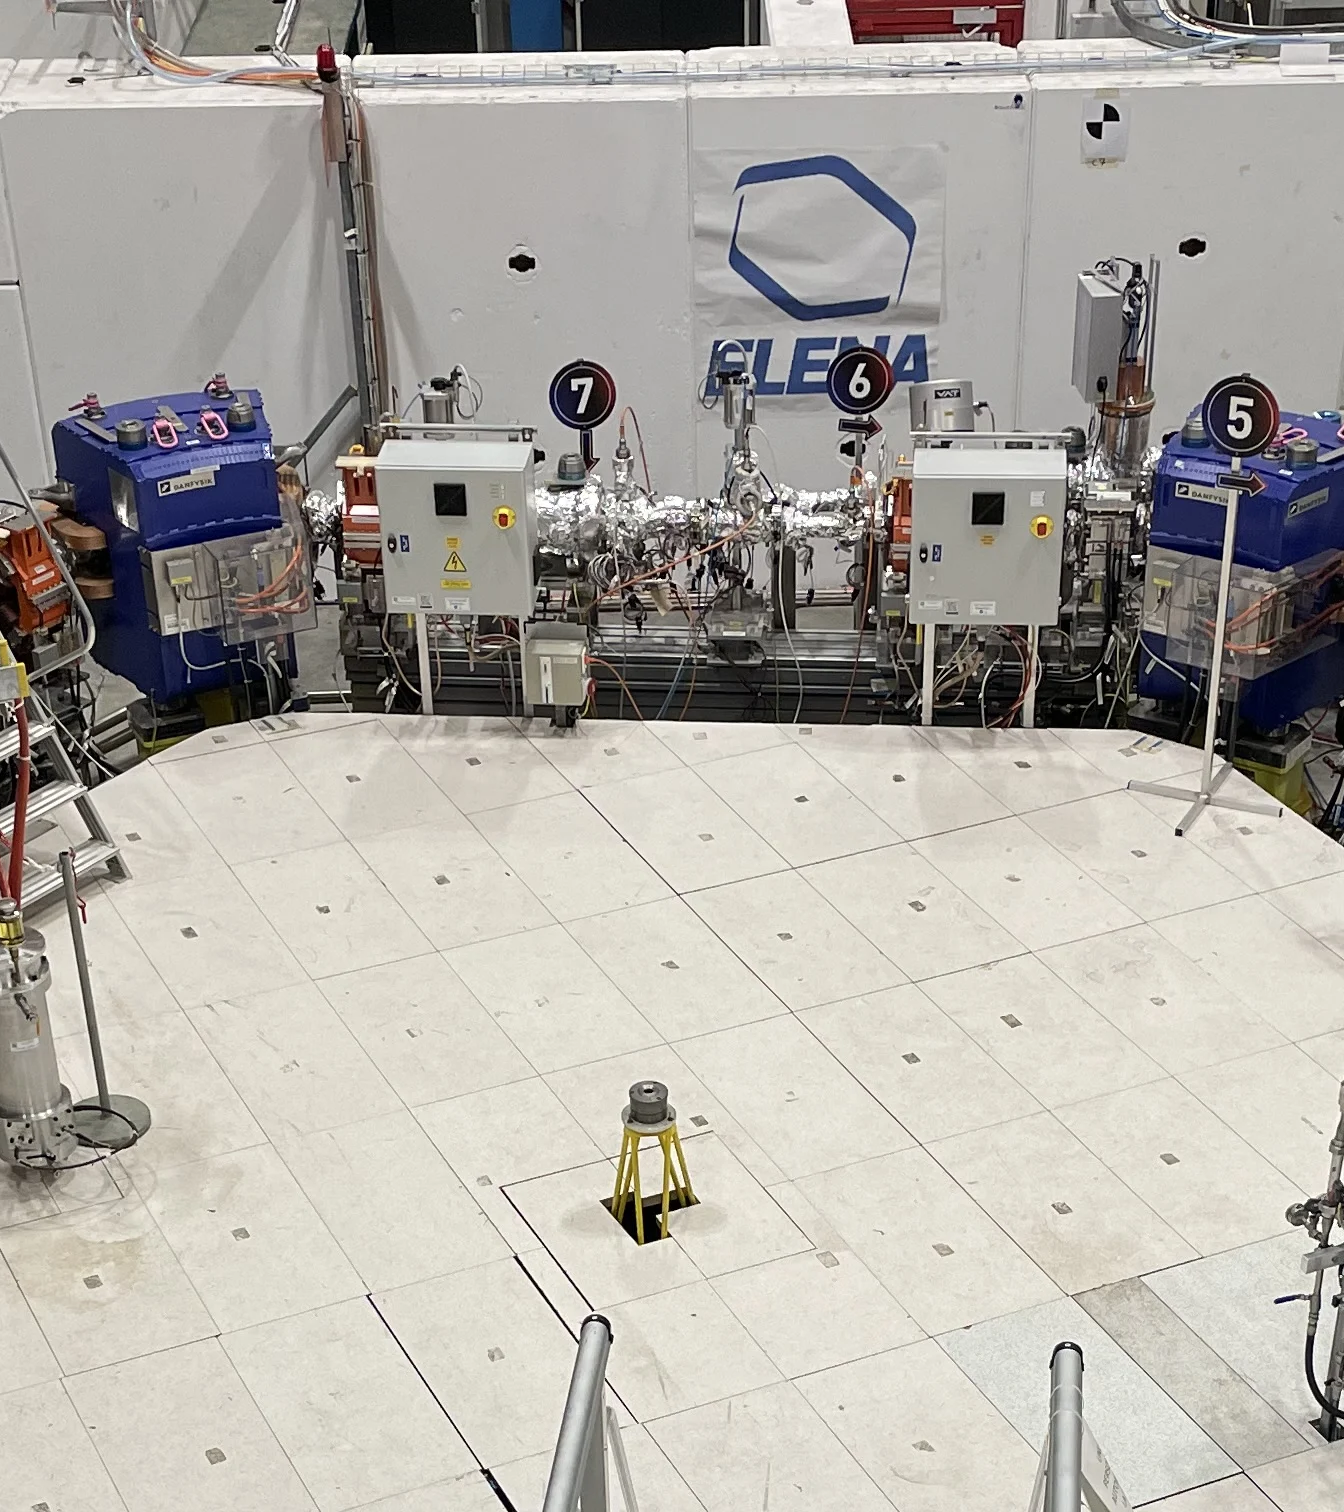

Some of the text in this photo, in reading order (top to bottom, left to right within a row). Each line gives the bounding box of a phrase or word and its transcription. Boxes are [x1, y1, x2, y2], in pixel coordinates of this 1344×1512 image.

[570, 378, 594, 414] 7
[848, 362, 871, 399] 6
[937, 389, 960, 398] VAT
[1228, 398, 1254, 440] 5
[173, 478, 213, 491] DANFYSIK
